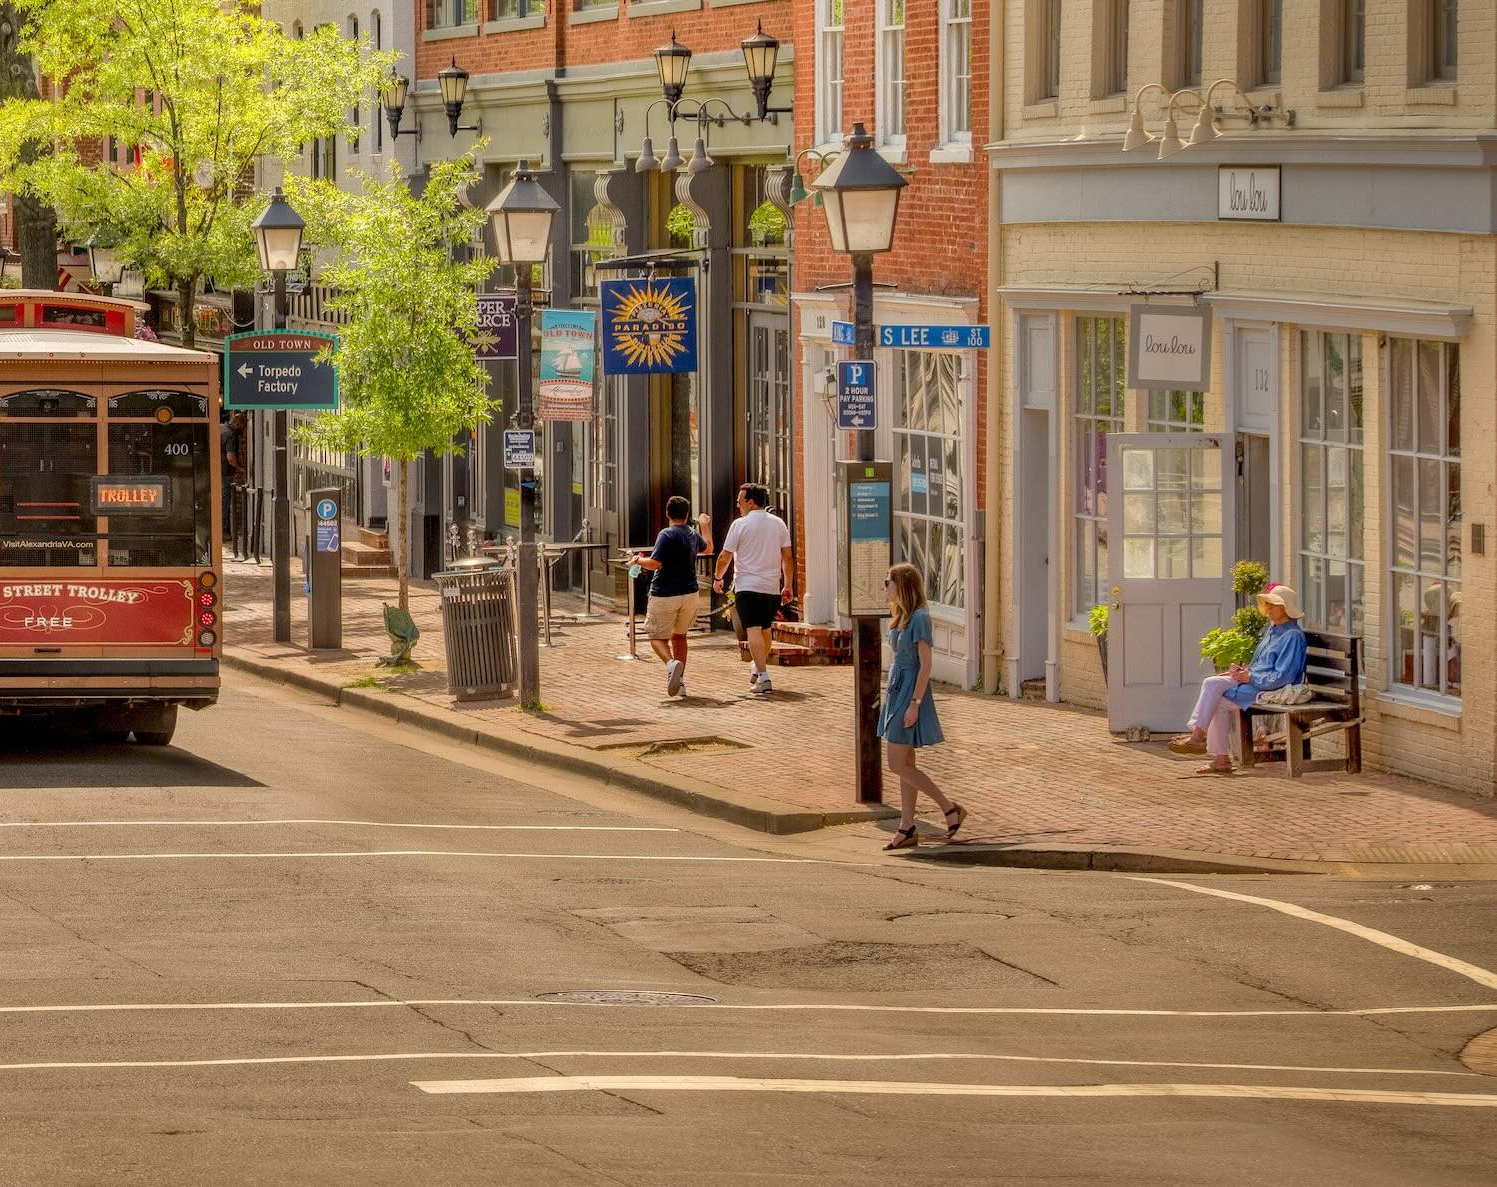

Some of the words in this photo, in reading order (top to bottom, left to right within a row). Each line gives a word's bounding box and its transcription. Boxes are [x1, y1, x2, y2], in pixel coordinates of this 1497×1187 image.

[614, 322, 685, 332] PARADISO
[543, 329, 562, 337] OLD
[565, 330, 592, 339] TOWN
[884, 328, 893, 345] S
[902, 328, 929, 345] LEE
[253, 341, 275, 350] OLD
[279, 340, 311, 349] TOWN
[968, 337, 983, 346] 100
[258, 365, 302, 378] Torpedo
[850, 365, 863, 385] P
[1254, 368, 1269, 392] 132
[258, 380, 298, 395] Factory
[845, 387, 850, 395] 2
[851, 387, 868, 395] HOUR
[164, 443, 189, 456] 400
[101, 489, 158, 503] TROLLEY
[323, 503, 332, 517] P
[3, 540, 94, 548] VisitAlexandriaVA.com
[3, 585, 63, 597] STREET
[67, 585, 140, 604] TROLLEY
[24, 617, 73, 627] FREE
